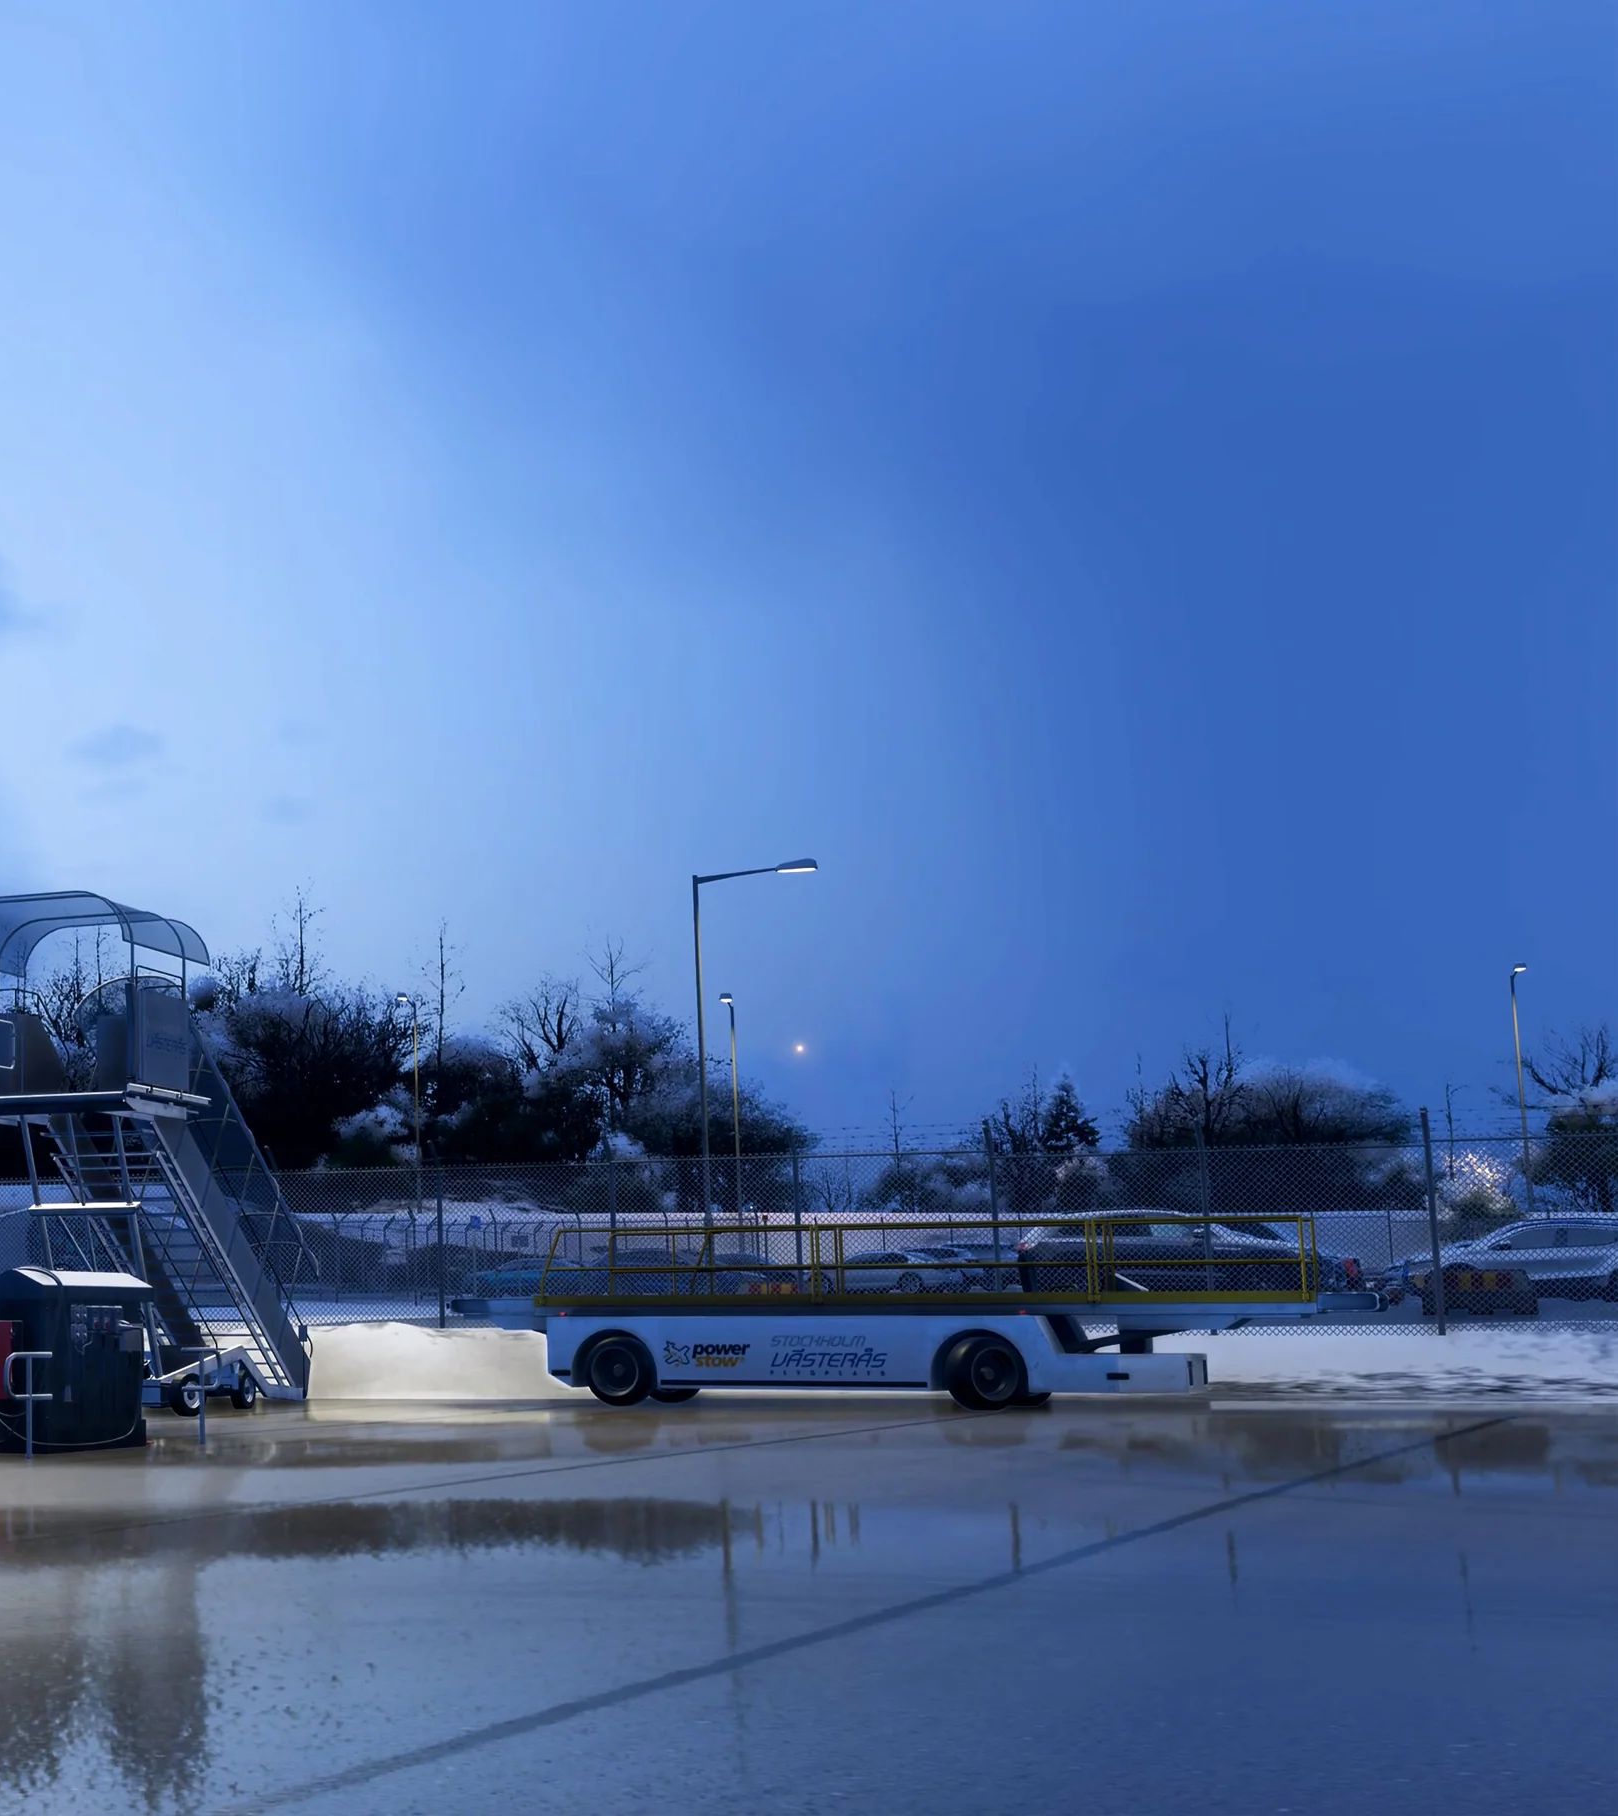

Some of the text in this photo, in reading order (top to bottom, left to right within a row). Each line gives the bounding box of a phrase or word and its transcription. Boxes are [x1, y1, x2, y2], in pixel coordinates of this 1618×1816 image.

[770, 1334, 866, 1347] STOCKHOLM
[692, 1343, 751, 1359] power
[770, 1348, 888, 1368] VÄSTERÅS
[695, 1355, 739, 1367] stow
